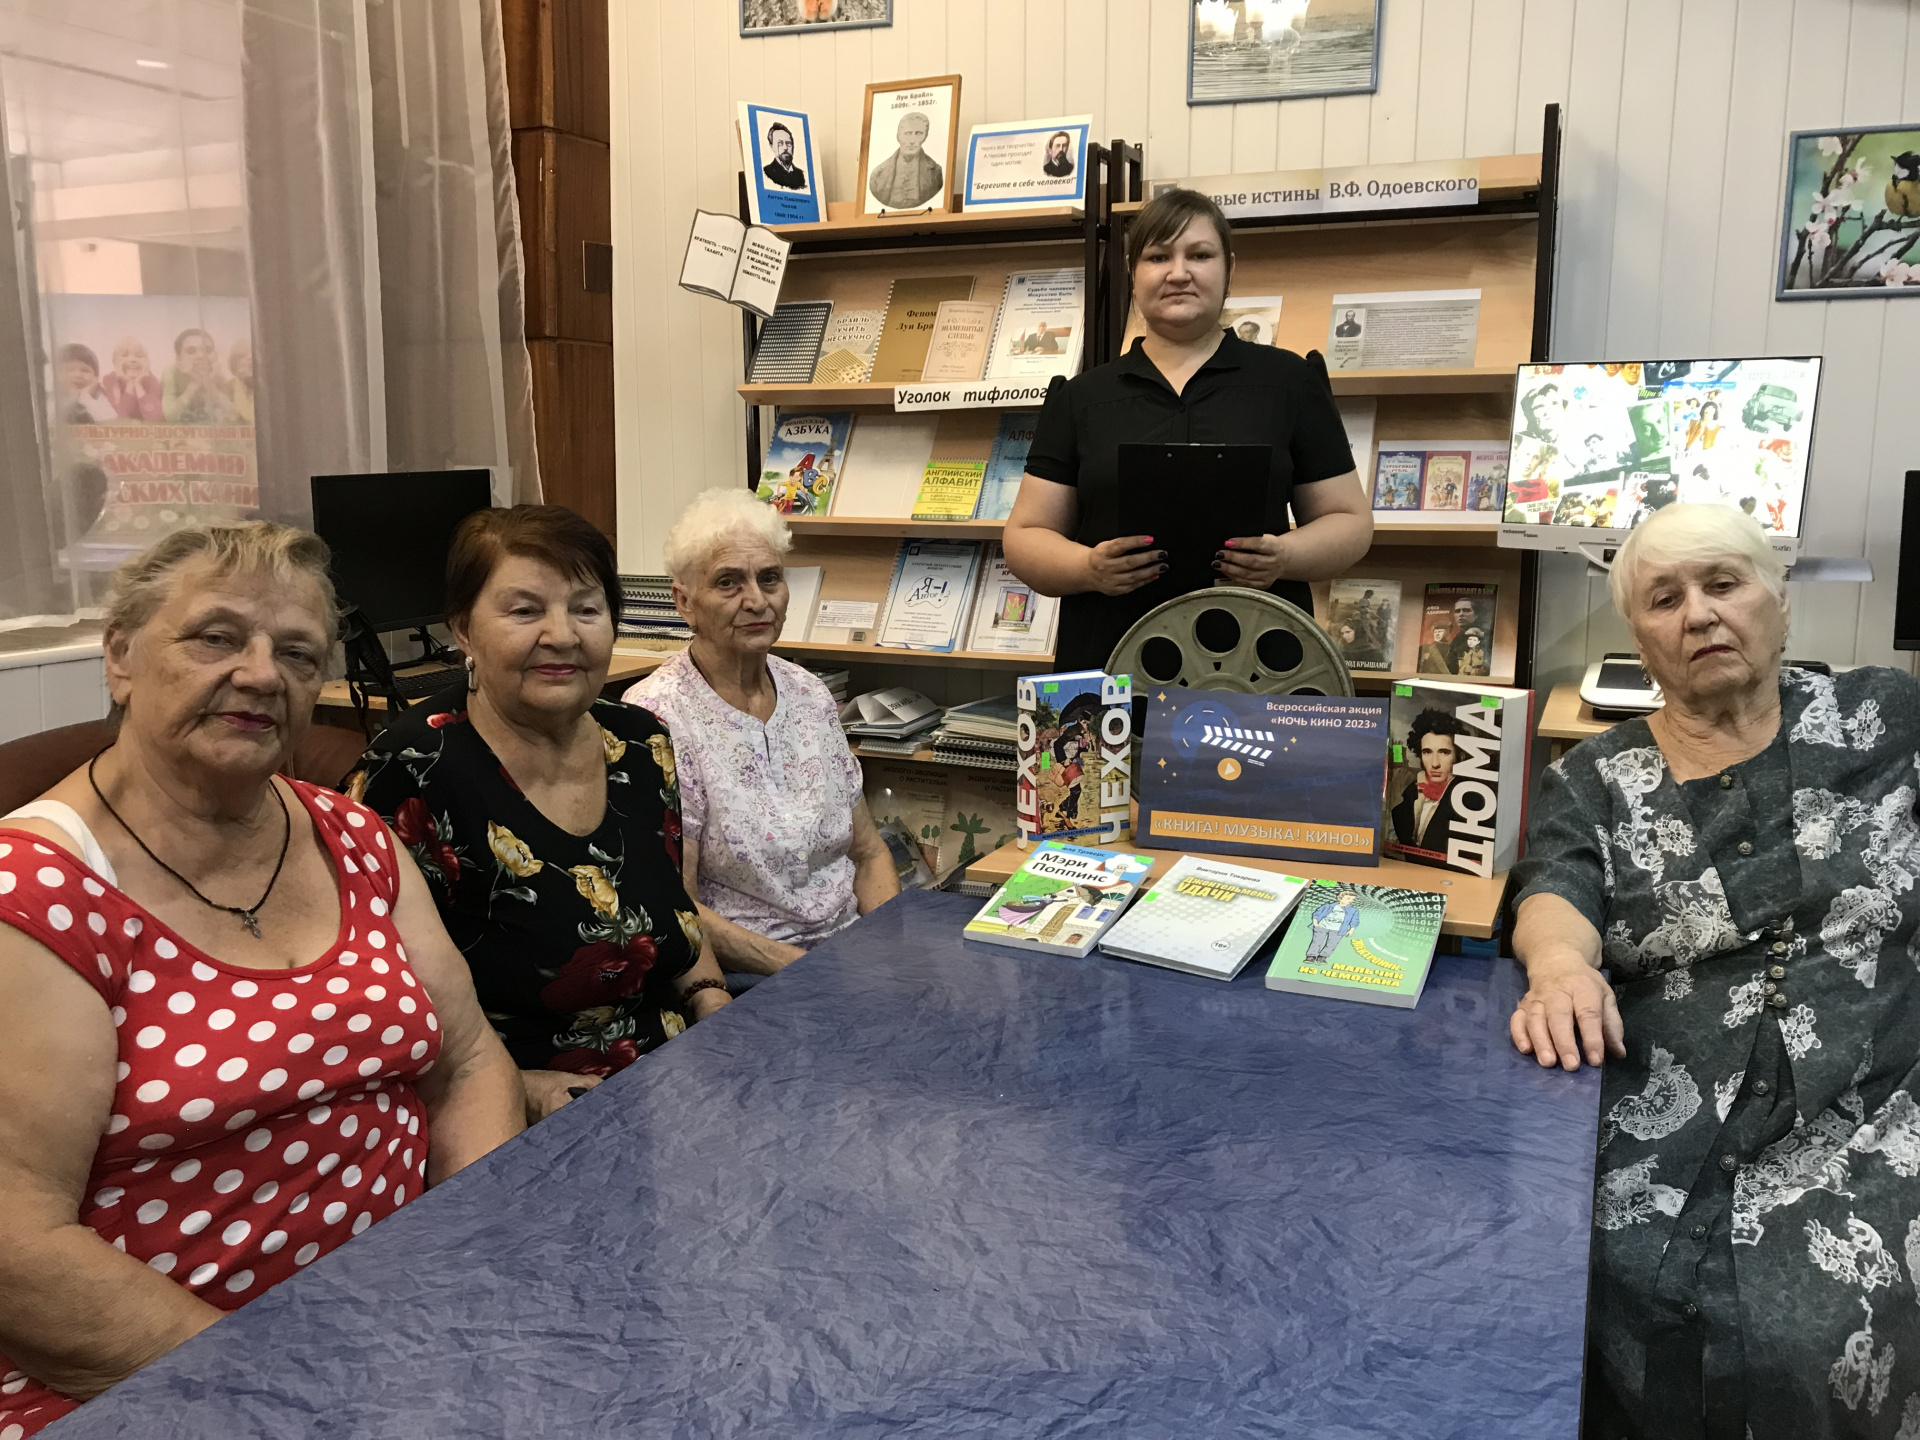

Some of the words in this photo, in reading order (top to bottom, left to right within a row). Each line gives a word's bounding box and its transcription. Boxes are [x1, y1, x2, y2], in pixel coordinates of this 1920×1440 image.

[1251, 188, 1321, 205] истины
[1329, 180, 1363, 200] В.Ф.
[1367, 177, 1478, 199] Одоевского
[694, 235, 717, 247] КРАТКОСТЬ
[721, 245, 737, 254] СЕСТРА
[836, 317, 870, 325] БРАЙЛЬ
[896, 323, 914, 332] Луи
[941, 325, 984, 333] ЗНАМЕНИТЫЕ
[947, 332, 976, 340] СЛЕПЫЕ
[826, 334, 872, 343] НЕСКУЧНО
[898, 390, 951, 404] Уголок
[785, 425, 830, 437] АЗБУКА
[103, 452, 246, 476] АКАДЕМИЯ
[925, 470, 982, 478] АНГЛИЙСКИЙ
[923, 477, 980, 487] АЛФАВИТ
[190, 483, 259, 509] КАНИ
[1356, 661, 1389, 669] КРЫШАМИ
[1266, 702, 1346, 714] Всероссийская
[1348, 706, 1382, 715] акция
[1271, 716, 1308, 726] «НОЧЬ
[1310, 717, 1342, 728] КИНО
[1344, 719, 1377, 729] 2023»
[1017, 680, 1037, 849] ЧЕХОВ
[1100, 675, 1132, 844] ЧЕХОВ
[1447, 698, 1504, 879] ДЮМА
[1042, 829, 1085, 840] ЮМОРИСТИЧЕСКИЕ
[1085, 825, 1108, 835] РАССКАЗЫ
[1154, 818, 1218, 834] «КНИГА!
[1224, 823, 1300, 842] МУЗЫКА!
[1305, 828, 1370, 847] КИНО!»
[1040, 853, 1088, 868] Мэри
[1077, 849, 1106, 857] Трэверс
[1032, 862, 1108, 883] Поппинс
[1196, 866, 1228, 876] Виктория
[1230, 872, 1260, 883] Токарева
[1176, 882, 1237, 902] УДАЧИ
[1298, 966, 1318, 975] ИЗ
[1320, 969, 1400, 987] ЧЕМОДАНА
[1332, 963, 1404, 980] МАЛЬЧИК
